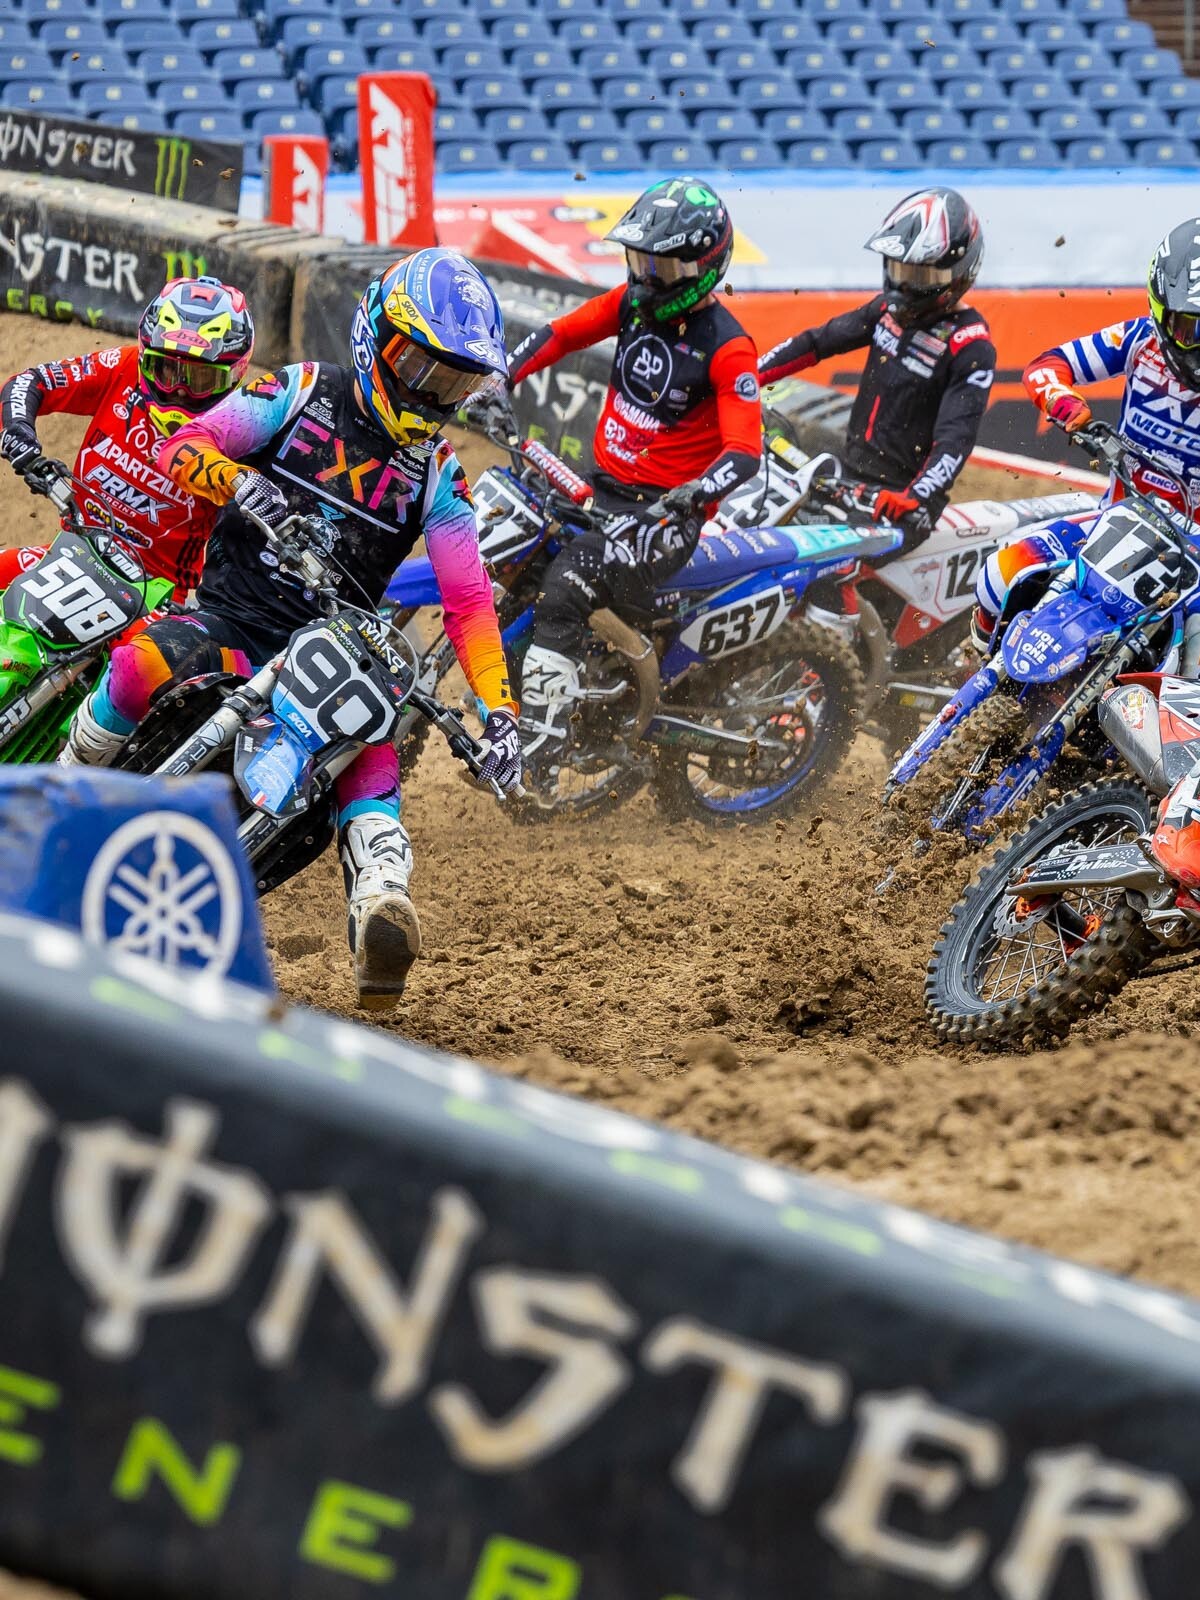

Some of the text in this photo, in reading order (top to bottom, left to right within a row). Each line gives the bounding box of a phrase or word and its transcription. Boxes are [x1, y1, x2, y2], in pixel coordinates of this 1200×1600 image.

[401, 300, 419, 321] SKDA
[122, 386, 143, 406] FST
[276, 415, 423, 526] FXR
[1143, 472, 1180, 493] LENCO
[84, 464, 177, 526] PRMX
[1081, 515, 1200, 608] 173
[20, 556, 128, 643] 508
[700, 595, 783, 658] 637
[1030, 627, 1063, 654] HOLE
[1021, 643, 1048, 665] ONE
[279, 637, 387, 743] 90
[287, 712, 314, 739] SKDA
